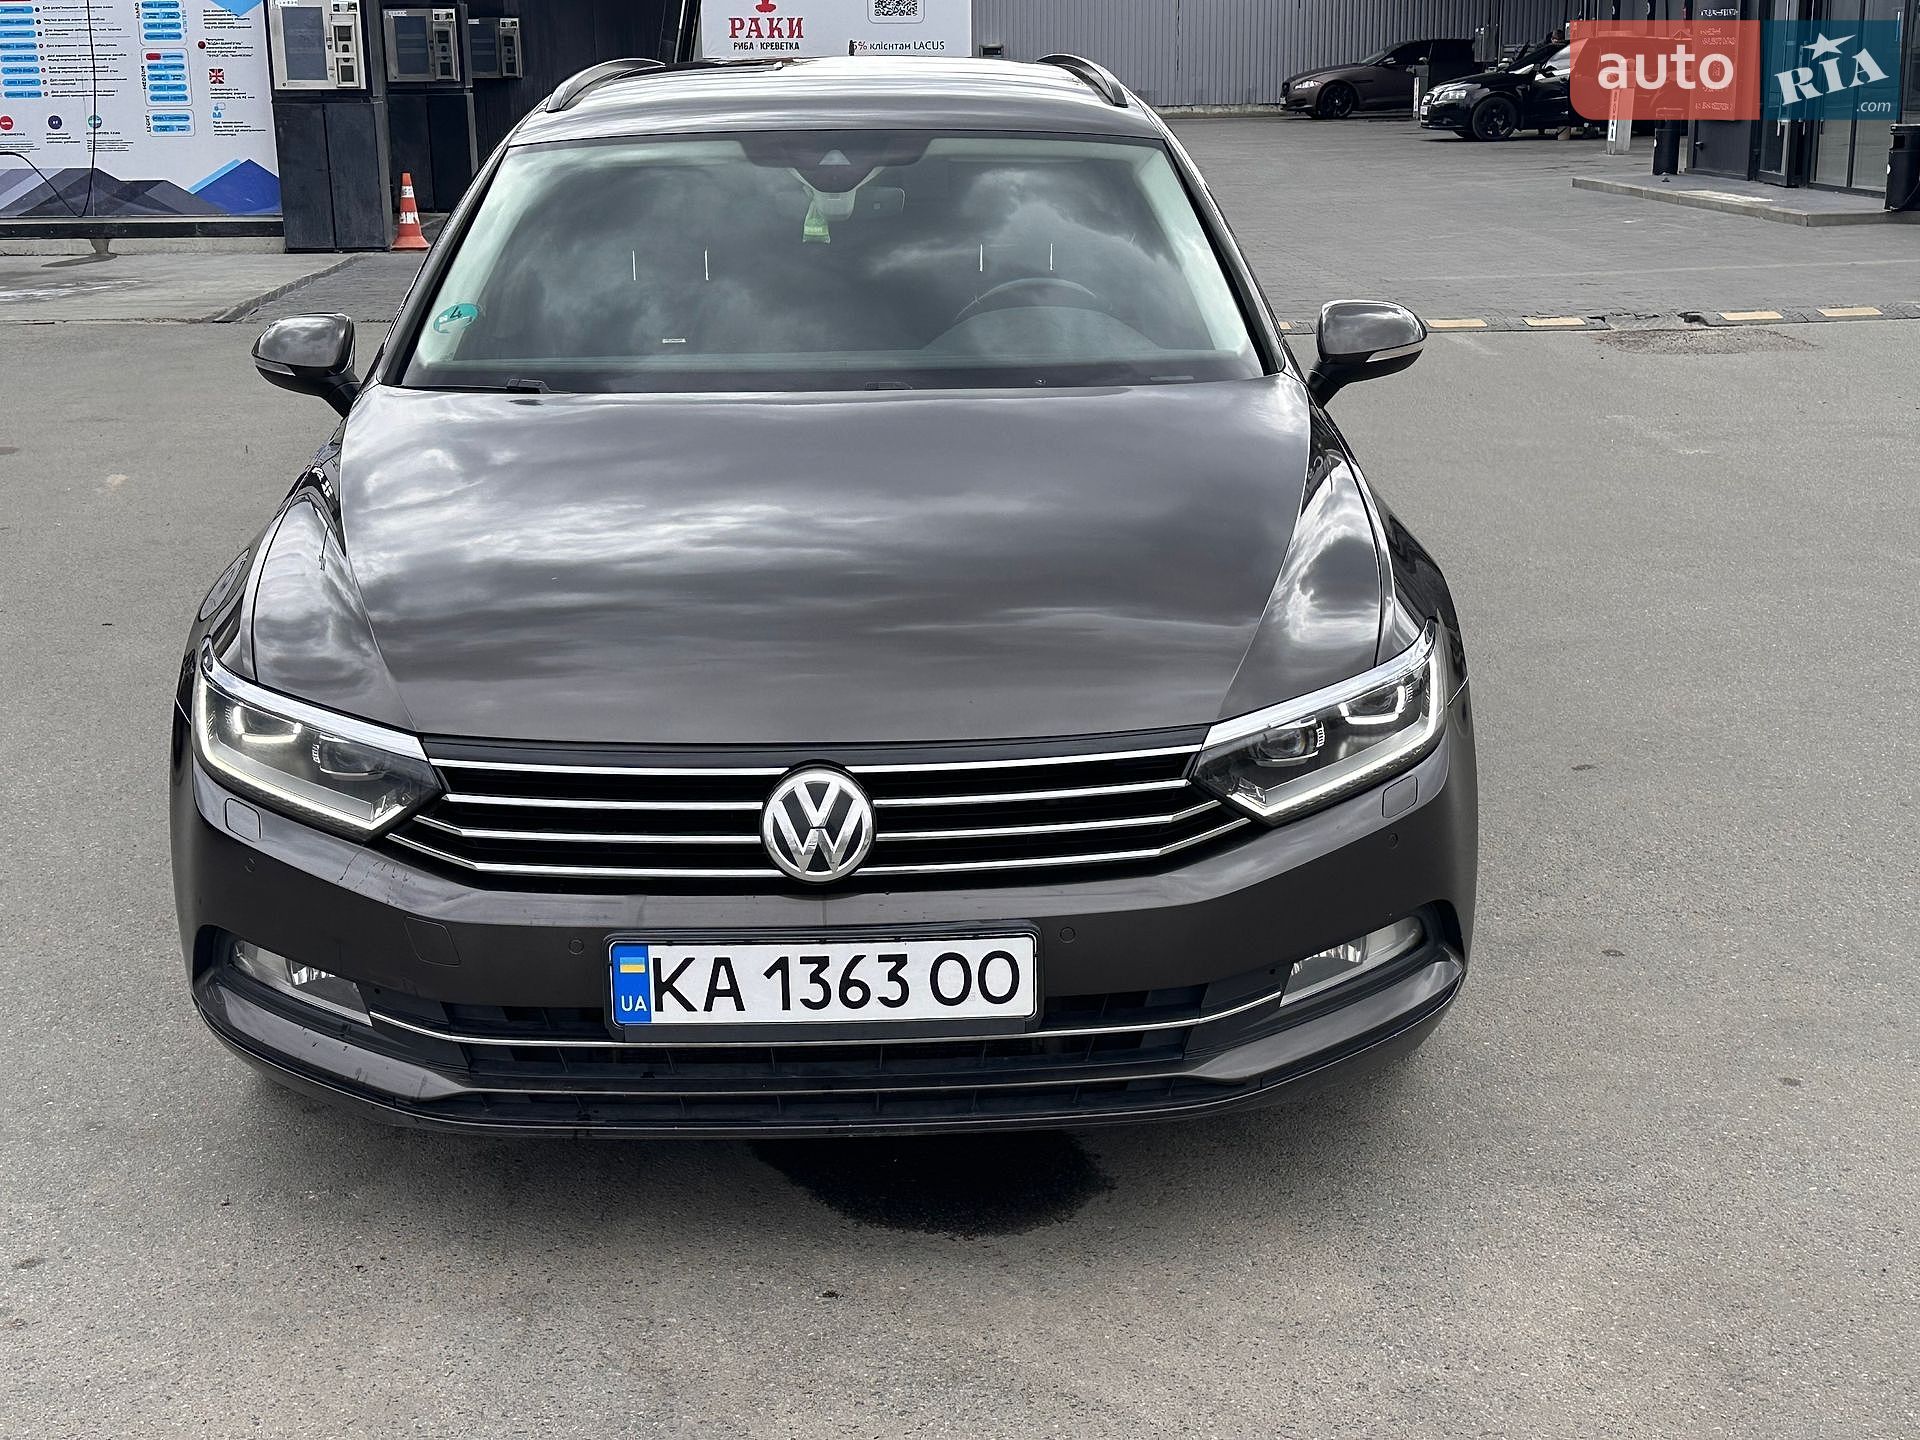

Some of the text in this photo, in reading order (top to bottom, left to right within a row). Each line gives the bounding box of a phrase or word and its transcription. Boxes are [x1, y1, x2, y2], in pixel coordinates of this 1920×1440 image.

[728, 17, 804, 39] РАКИ
[733, 42, 800, 50] РИБА КРЕВЕТКА
[869, 41, 911, 50] клієнтам
[913, 41, 945, 50] LACUS
[449, 305, 463, 319] 4
[652, 949, 1021, 1013] KA 1363 OO
[621, 995, 648, 1012] UA
